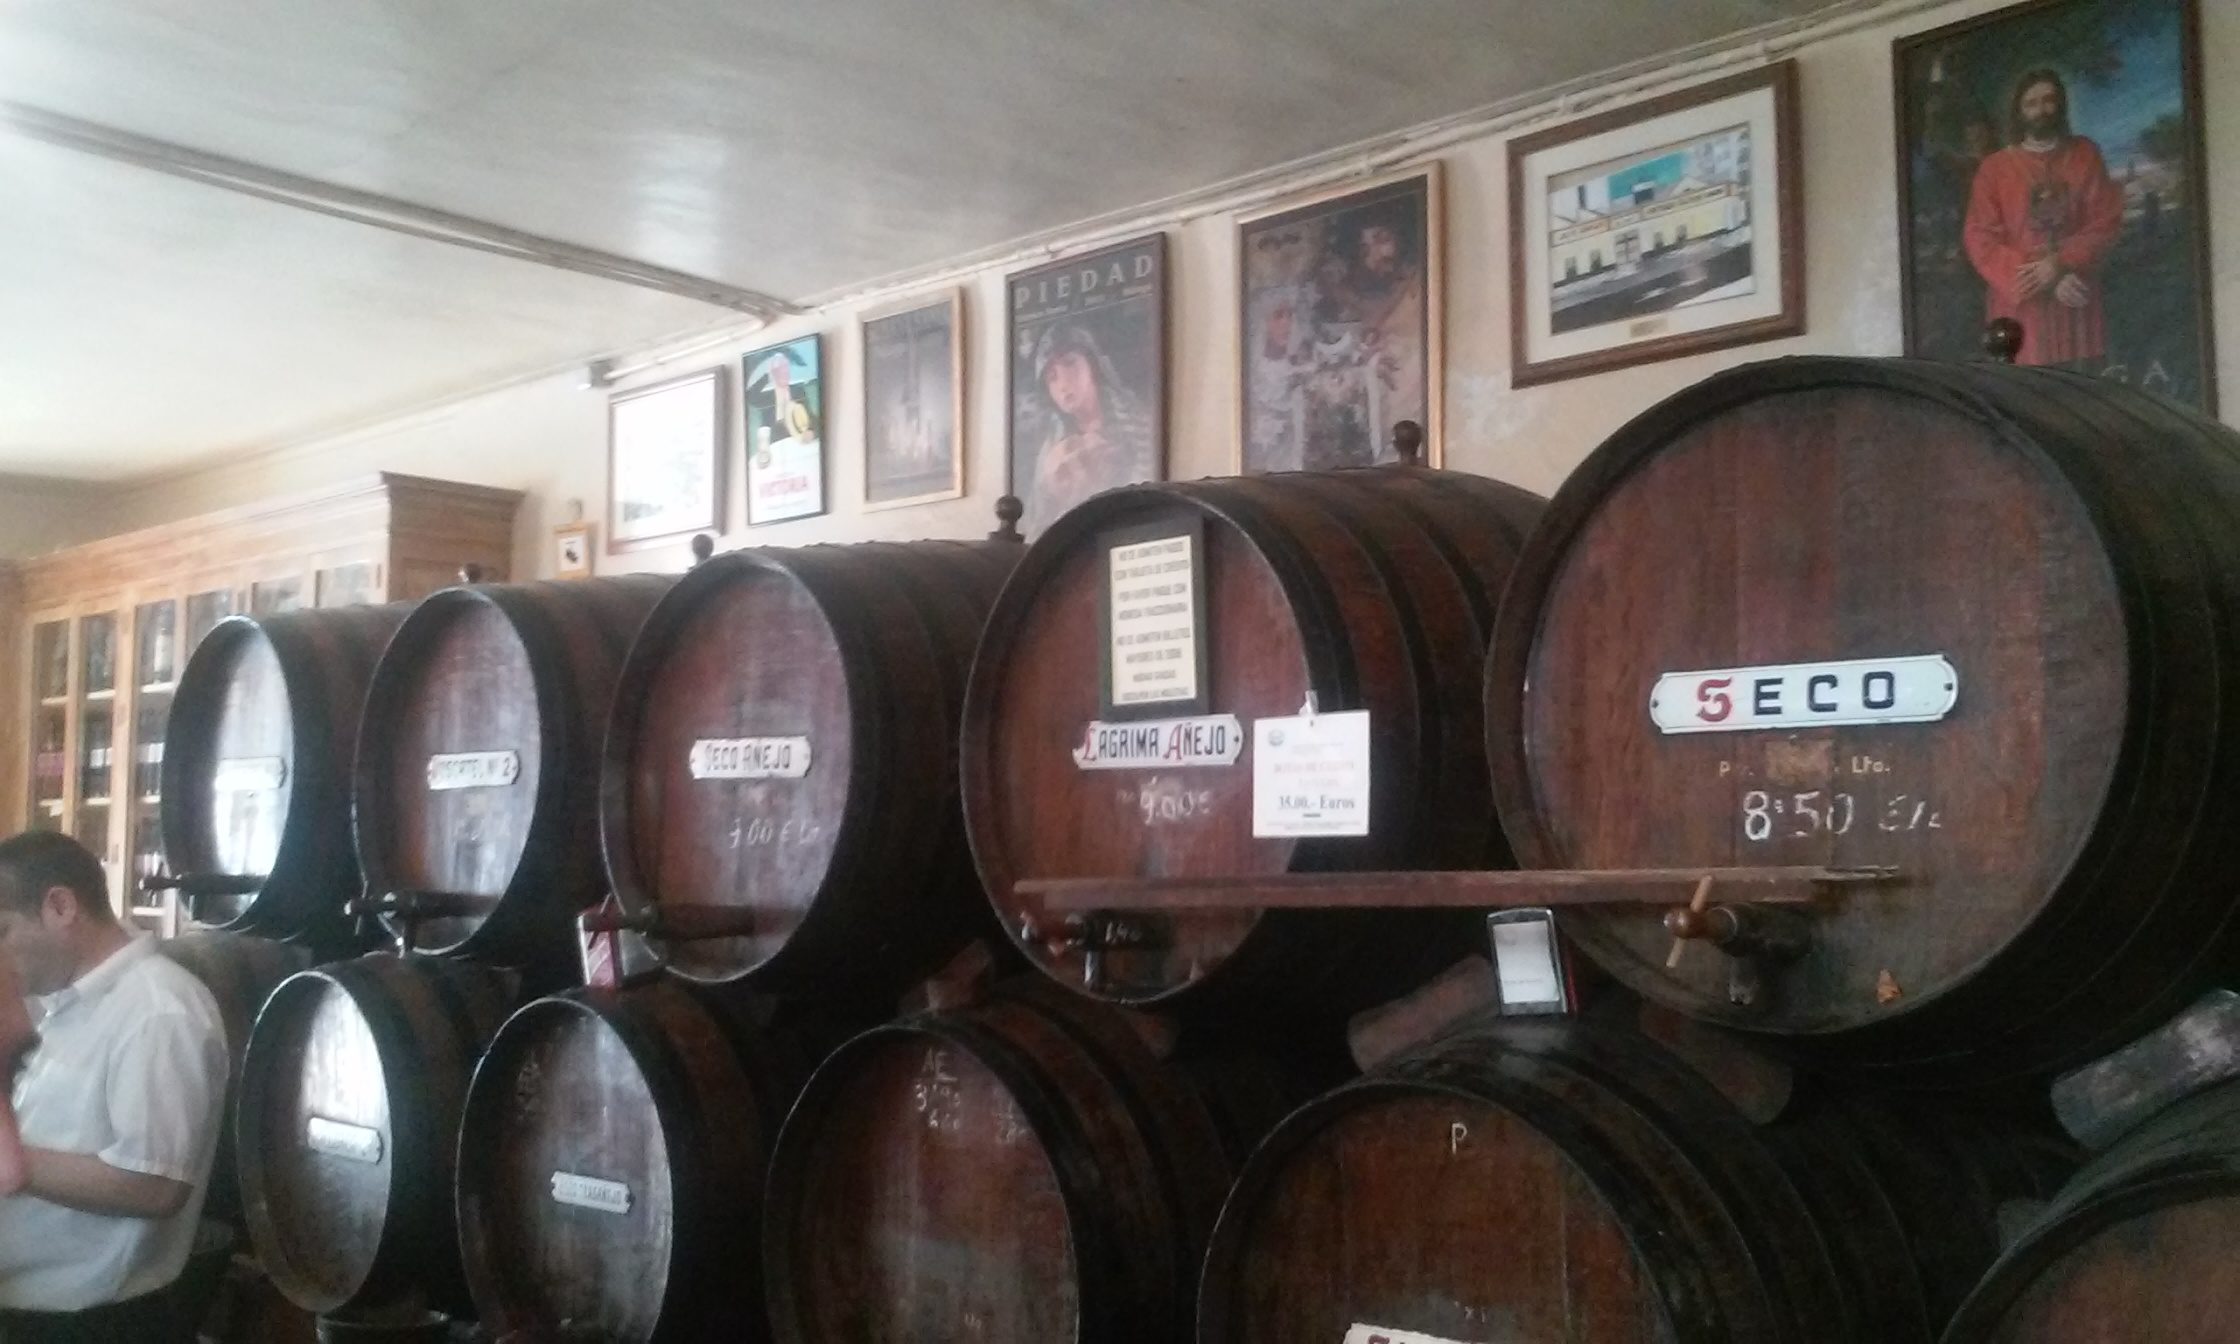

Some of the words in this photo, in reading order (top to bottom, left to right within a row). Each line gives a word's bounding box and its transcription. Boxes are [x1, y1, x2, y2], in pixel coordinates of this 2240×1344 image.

[1014, 254, 1153, 310] PIEDAD
[1696, 670, 1895, 723] SECO
[1162, 722, 1226, 761] AÑEJO
[1319, 793, 1356, 810] Euros
[1450, 1121, 1468, 1156] P
